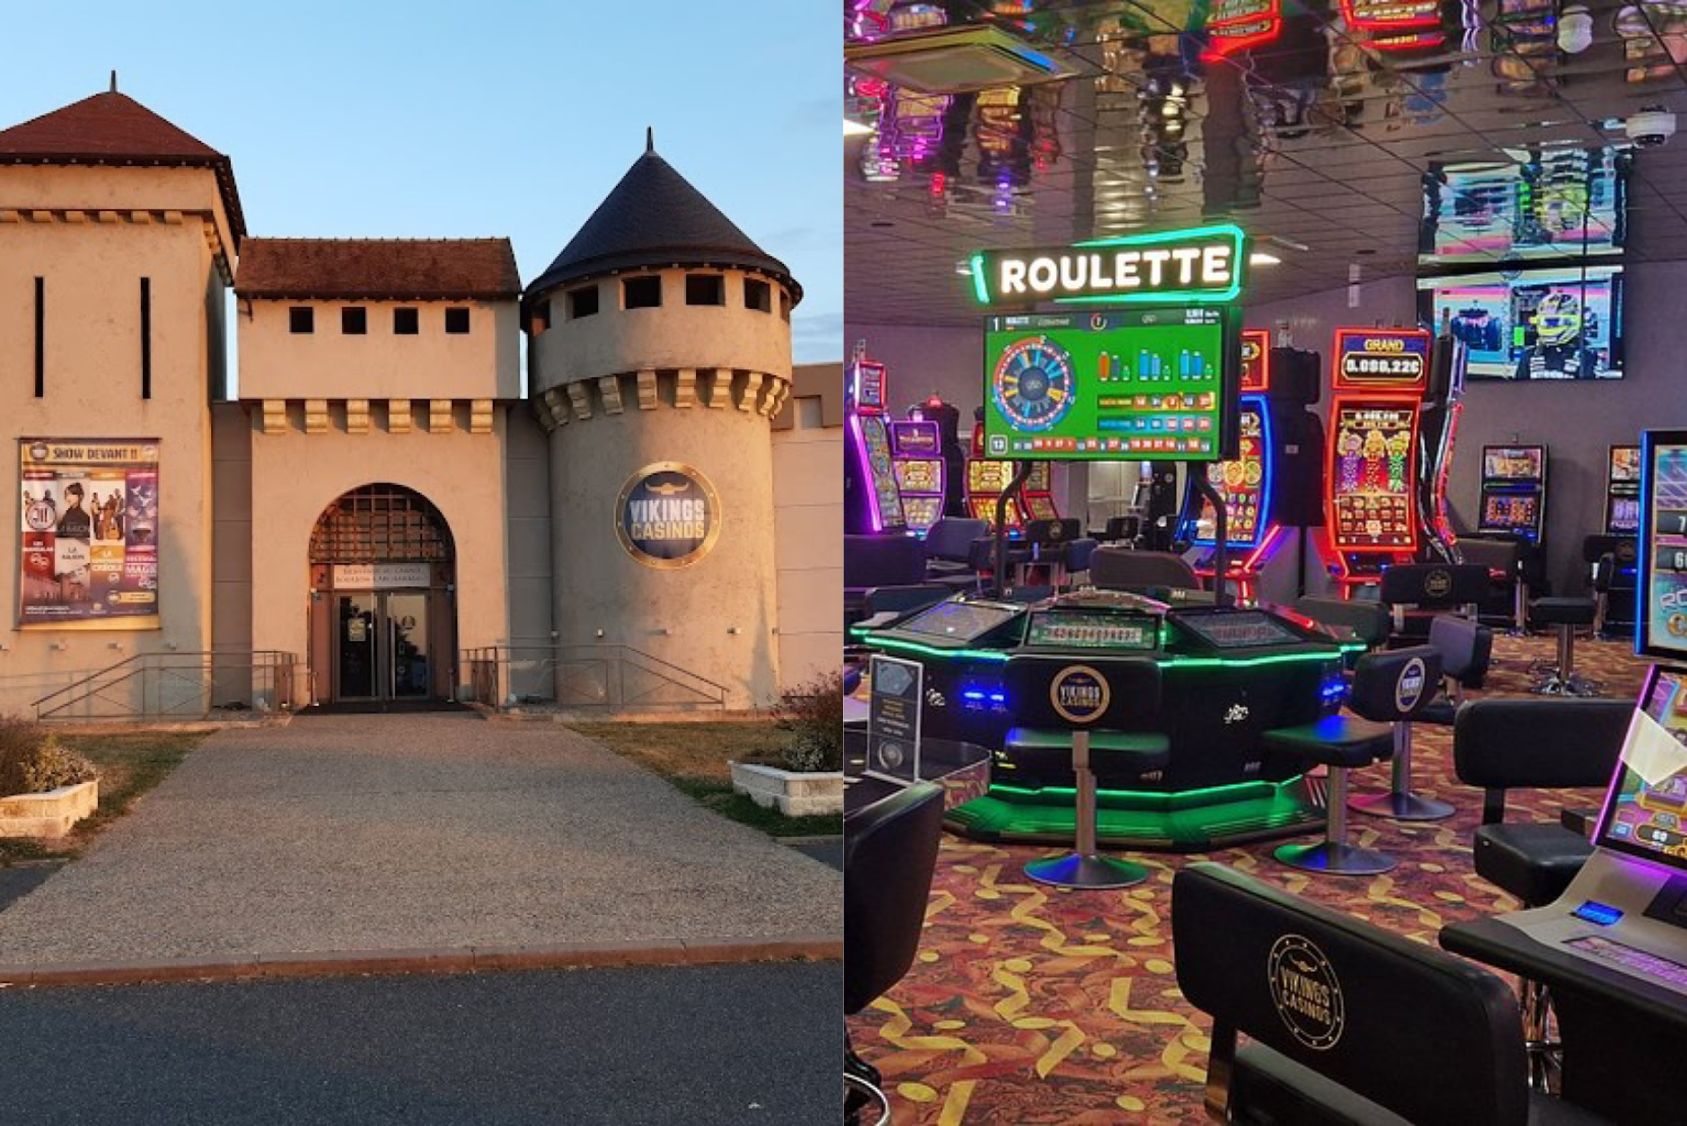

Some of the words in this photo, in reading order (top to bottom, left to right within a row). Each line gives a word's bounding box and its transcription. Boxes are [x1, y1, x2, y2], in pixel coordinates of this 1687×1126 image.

[999, 245, 1231, 294] ROULETTE
[1364, 338, 1405, 352] GRAND
[53, 447, 84, 460] SHOW
[87, 447, 128, 460] DEVANT
[629, 498, 705, 522] VIKINGS
[629, 521, 705, 540] CASINOS
[1280, 965, 1331, 1008] VIKINGS
[1281, 989, 1331, 1026] CASINOS
